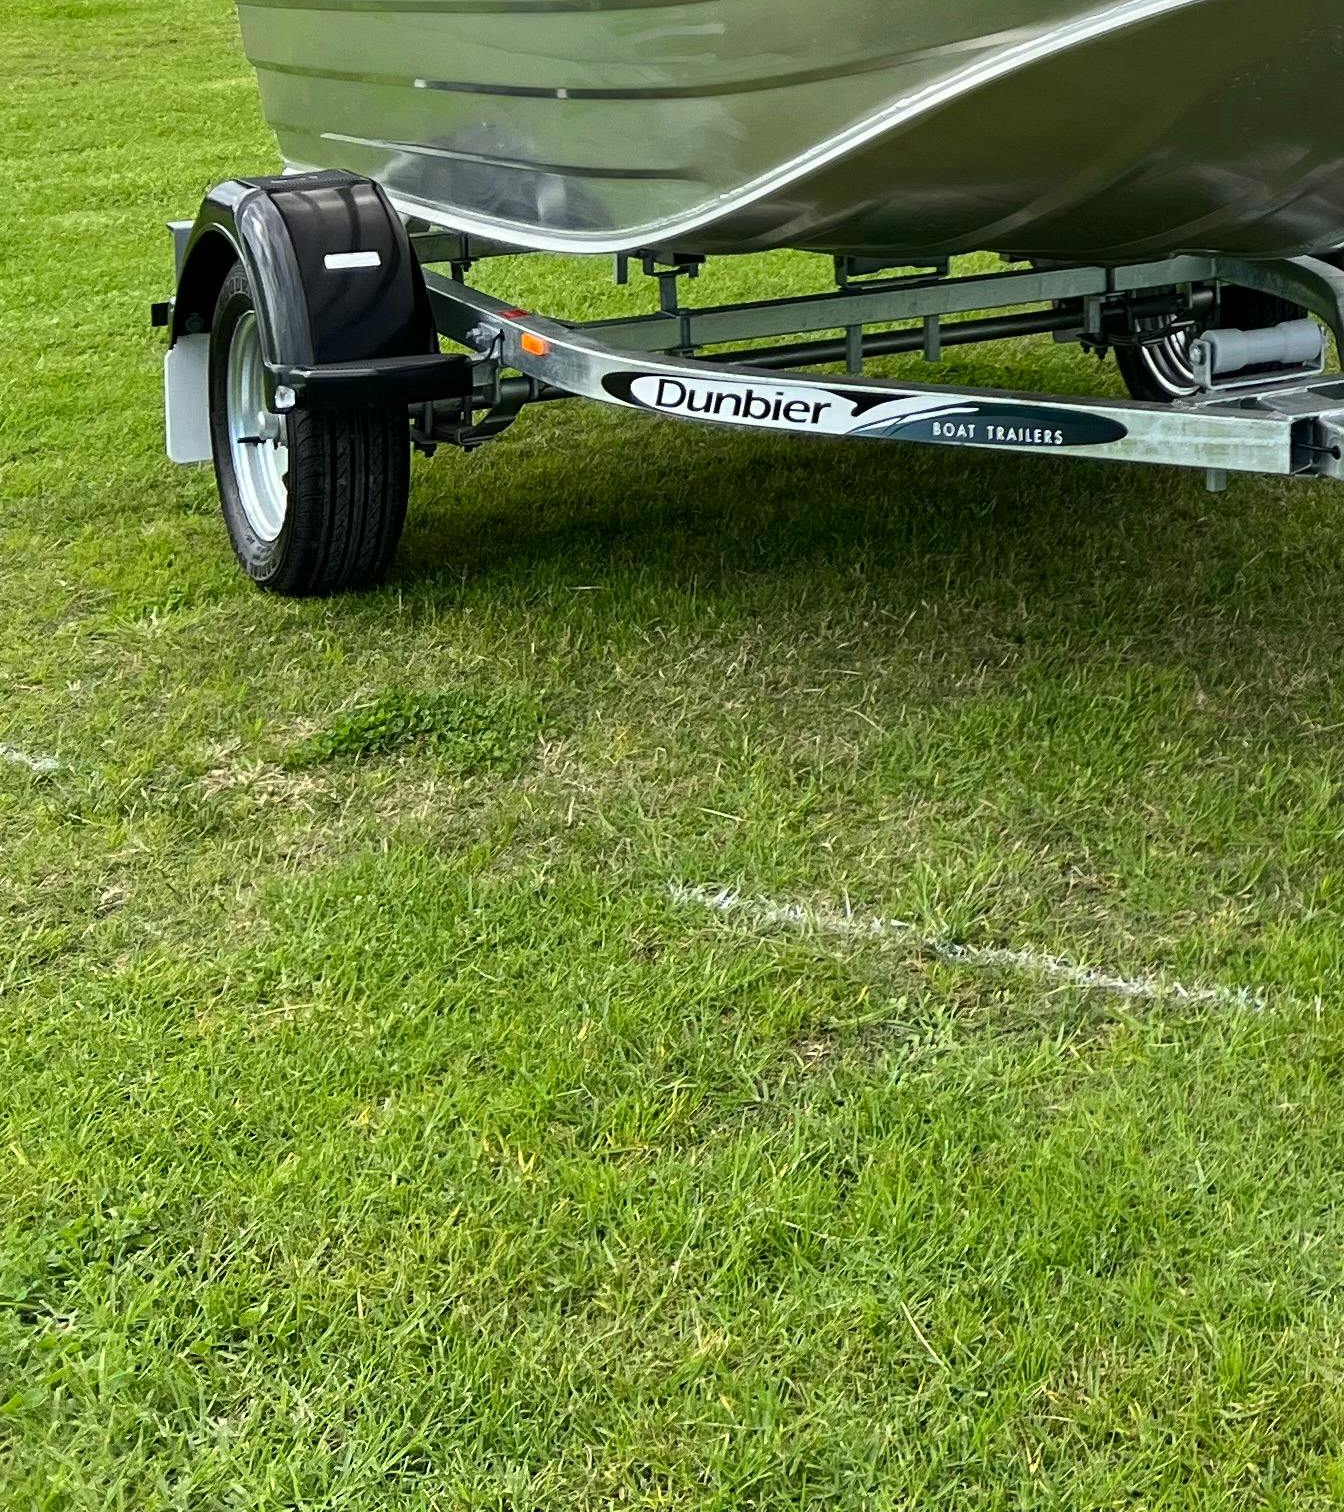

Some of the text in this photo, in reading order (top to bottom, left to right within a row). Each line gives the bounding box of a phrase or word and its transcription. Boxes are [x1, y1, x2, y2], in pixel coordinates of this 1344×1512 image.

[655, 377, 832, 425] Dunbier
[932, 421, 1063, 445] BOAT TRAILERS
